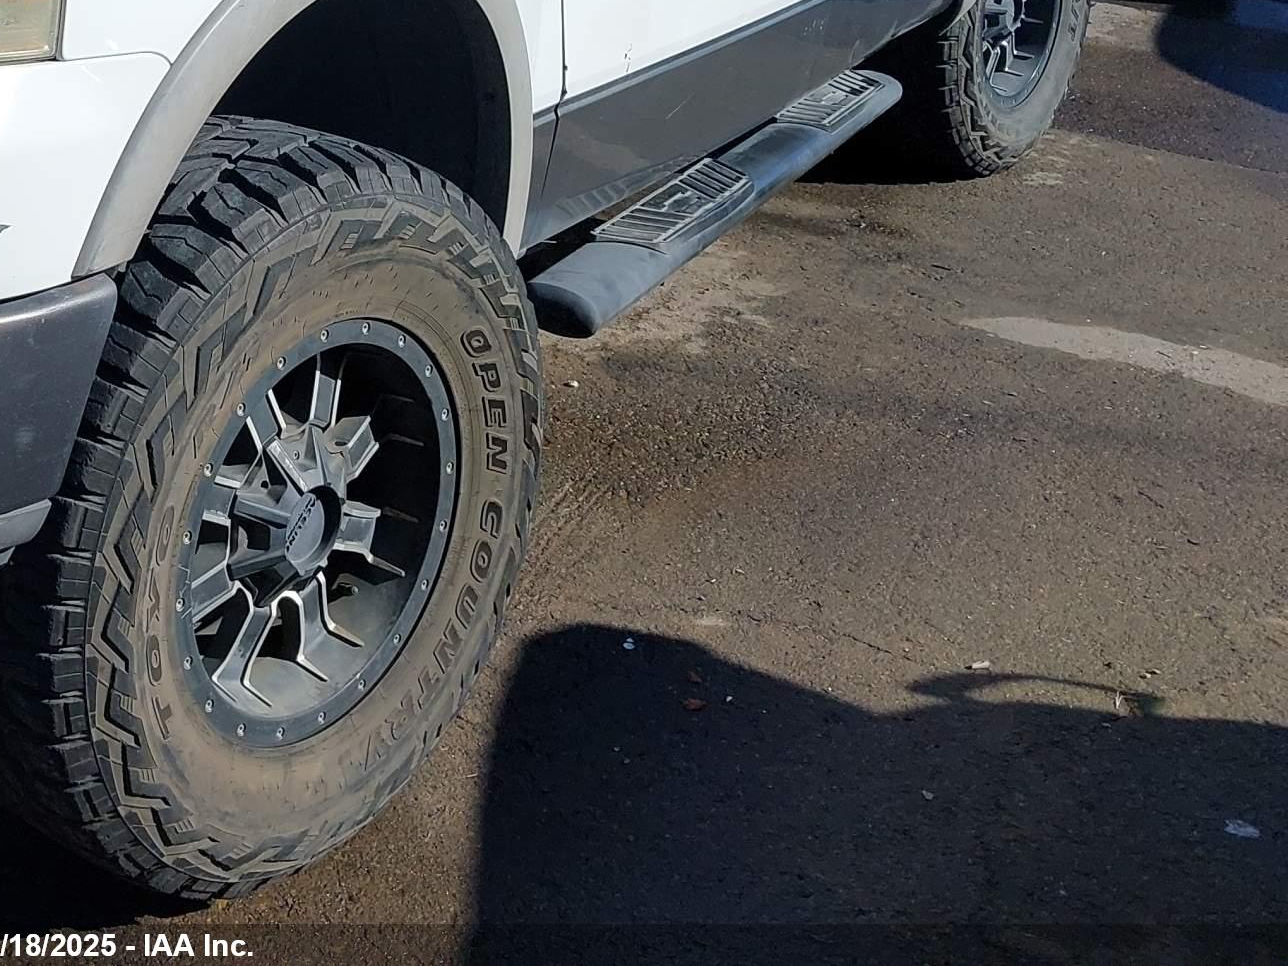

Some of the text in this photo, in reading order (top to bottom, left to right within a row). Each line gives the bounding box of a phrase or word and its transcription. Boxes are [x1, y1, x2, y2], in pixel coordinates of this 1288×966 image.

[145, 504, 175, 741] TOYO
[364, 328, 509, 772] OPEN COUNTRY
